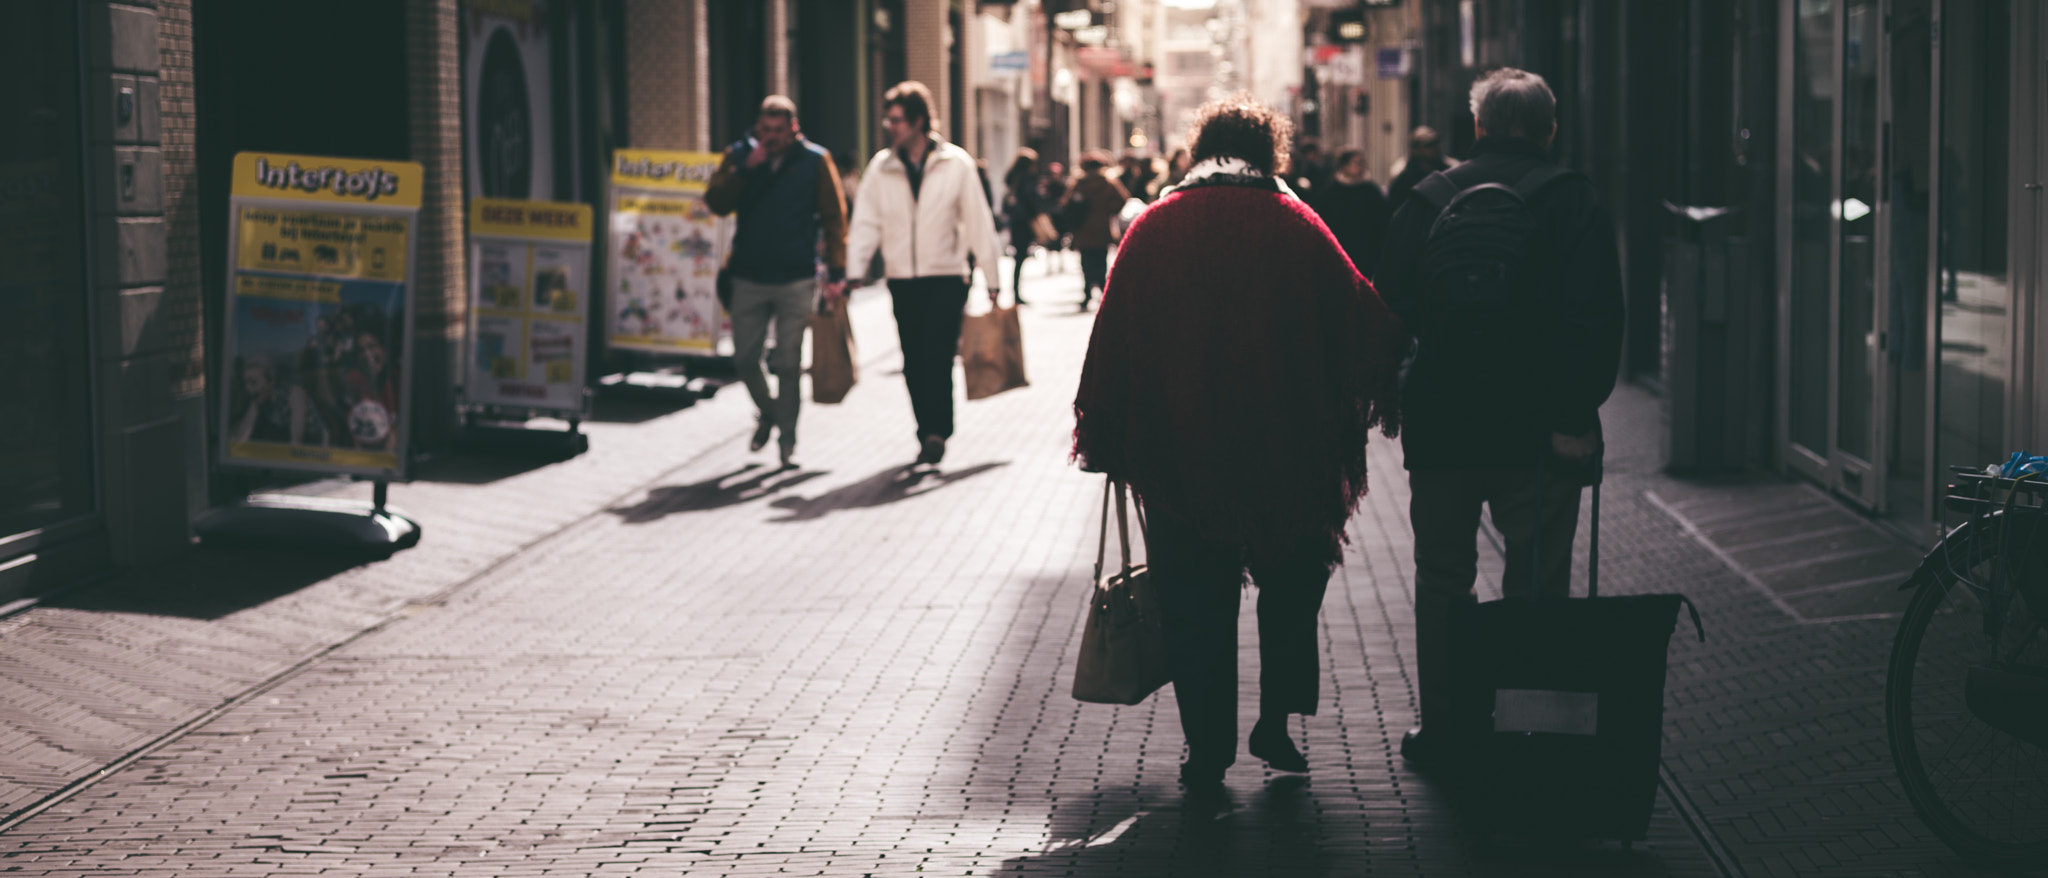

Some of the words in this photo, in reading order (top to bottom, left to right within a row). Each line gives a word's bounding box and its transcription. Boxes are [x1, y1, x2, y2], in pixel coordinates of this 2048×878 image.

[256, 156, 399, 200] Intertoys
[617, 154, 717, 182] Intertoy
[481, 205, 524, 225] DEZE
[529, 208, 579, 228] WEEK
